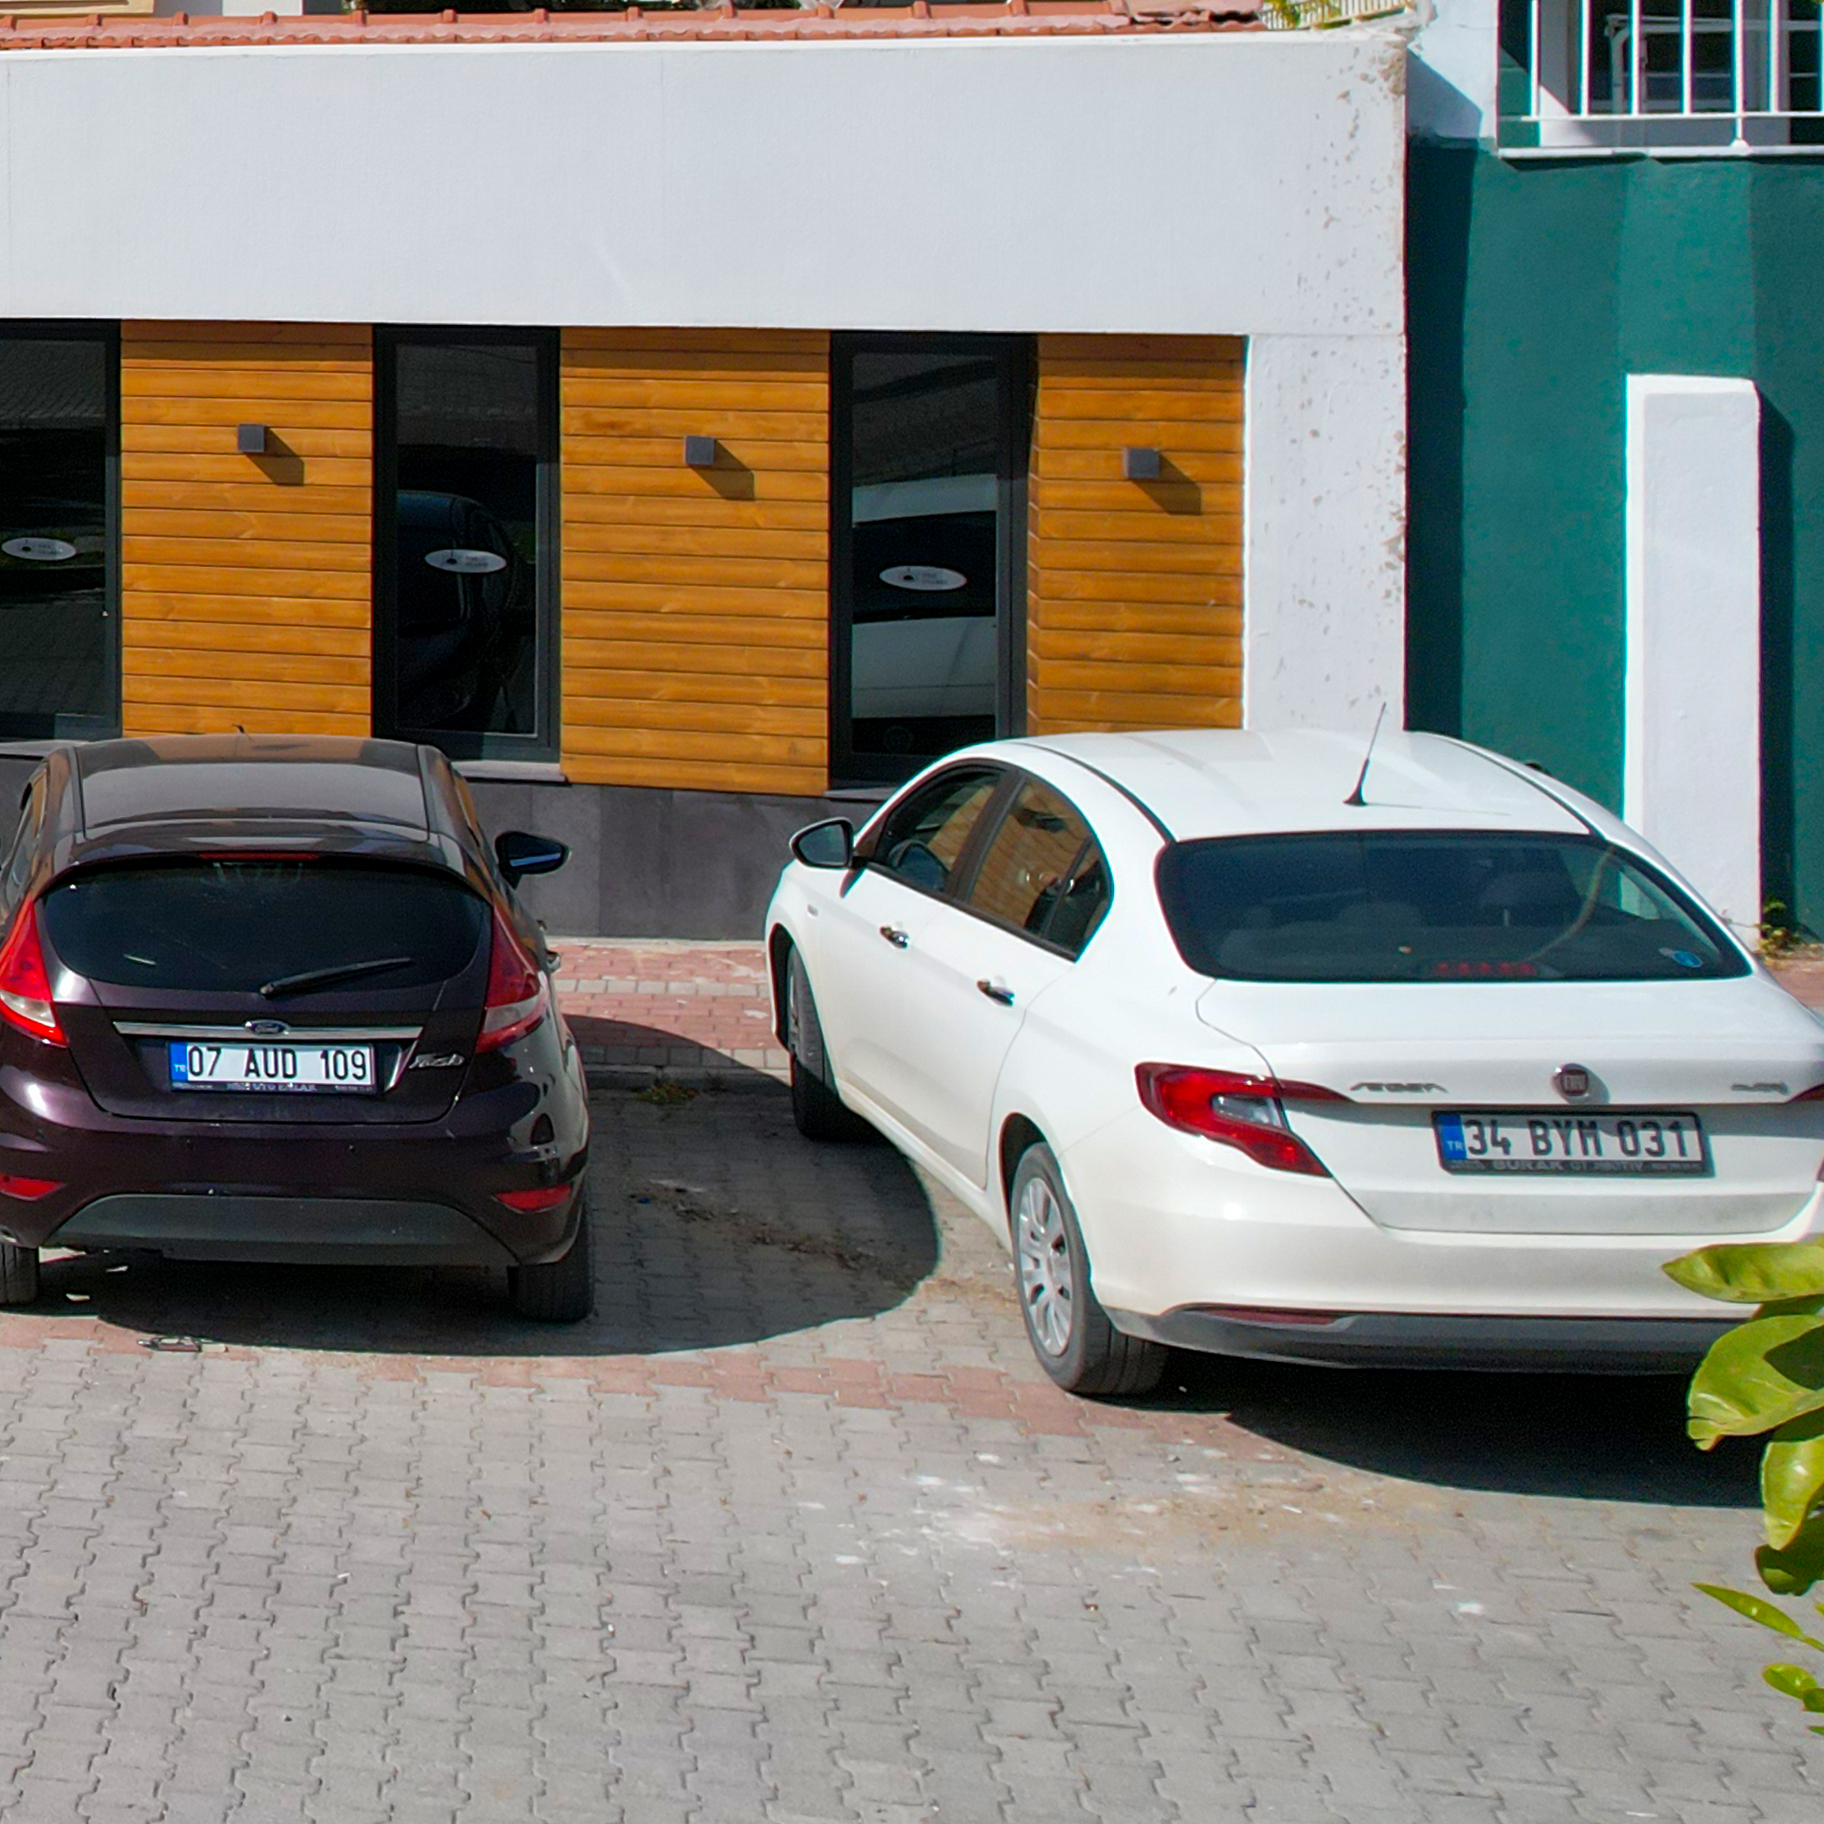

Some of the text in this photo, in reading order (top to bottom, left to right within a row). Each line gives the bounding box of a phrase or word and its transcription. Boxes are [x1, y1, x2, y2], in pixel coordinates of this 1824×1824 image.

[187, 1046, 366, 1080] 07 AUD 109
[1448, 1141, 1463, 1151] TR
[1464, 1119, 1689, 1158] 34 BYM 031
